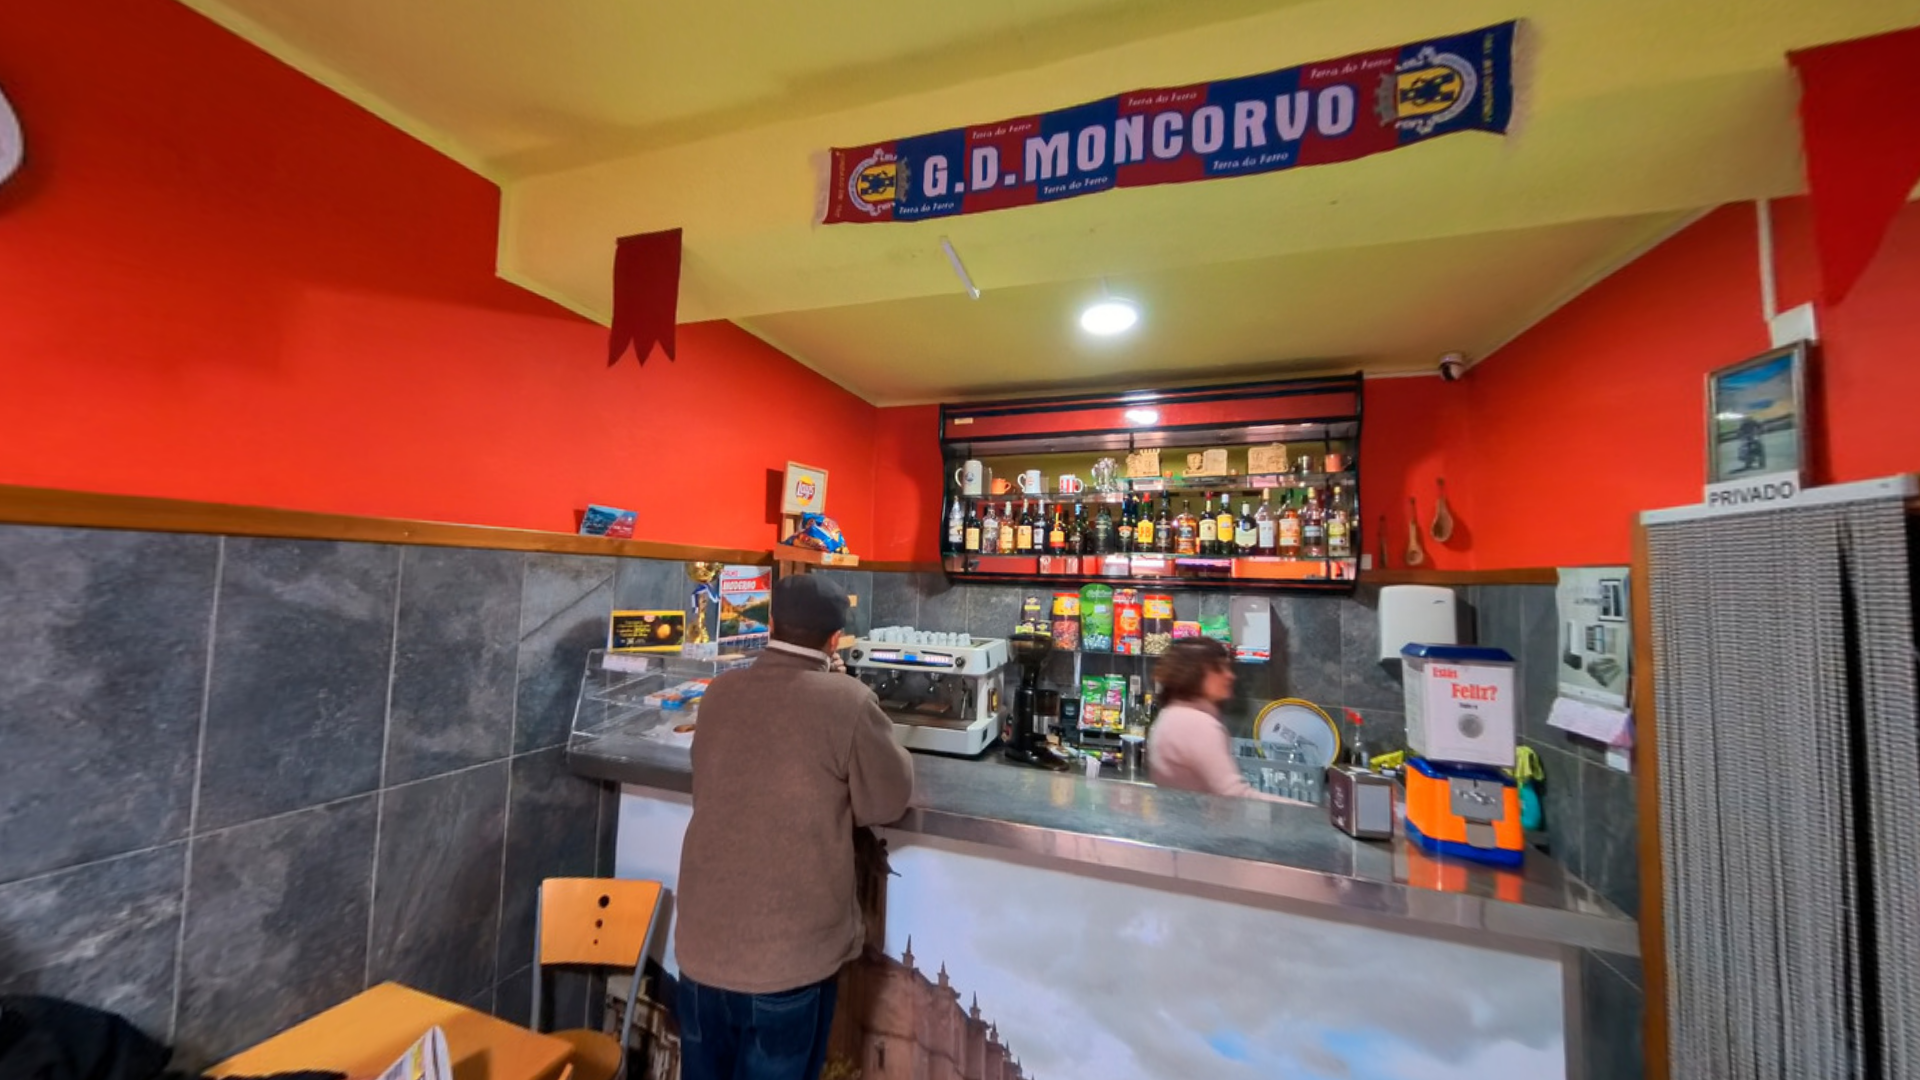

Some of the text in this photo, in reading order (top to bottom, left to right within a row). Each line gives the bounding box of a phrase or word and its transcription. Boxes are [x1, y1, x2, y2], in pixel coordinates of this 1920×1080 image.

[1310, 68, 1337, 80] Terra
[1127, 95, 1153, 107] Terra
[972, 130, 992, 140] Terra
[1213, 151, 1289, 171] Terra do Ferro
[1043, 175, 1108, 195] Terra do Ferro
[899, 205, 919, 215] Terra
[933, 200, 955, 211] Ferro
[1709, 481, 1793, 507] PRIVADO
